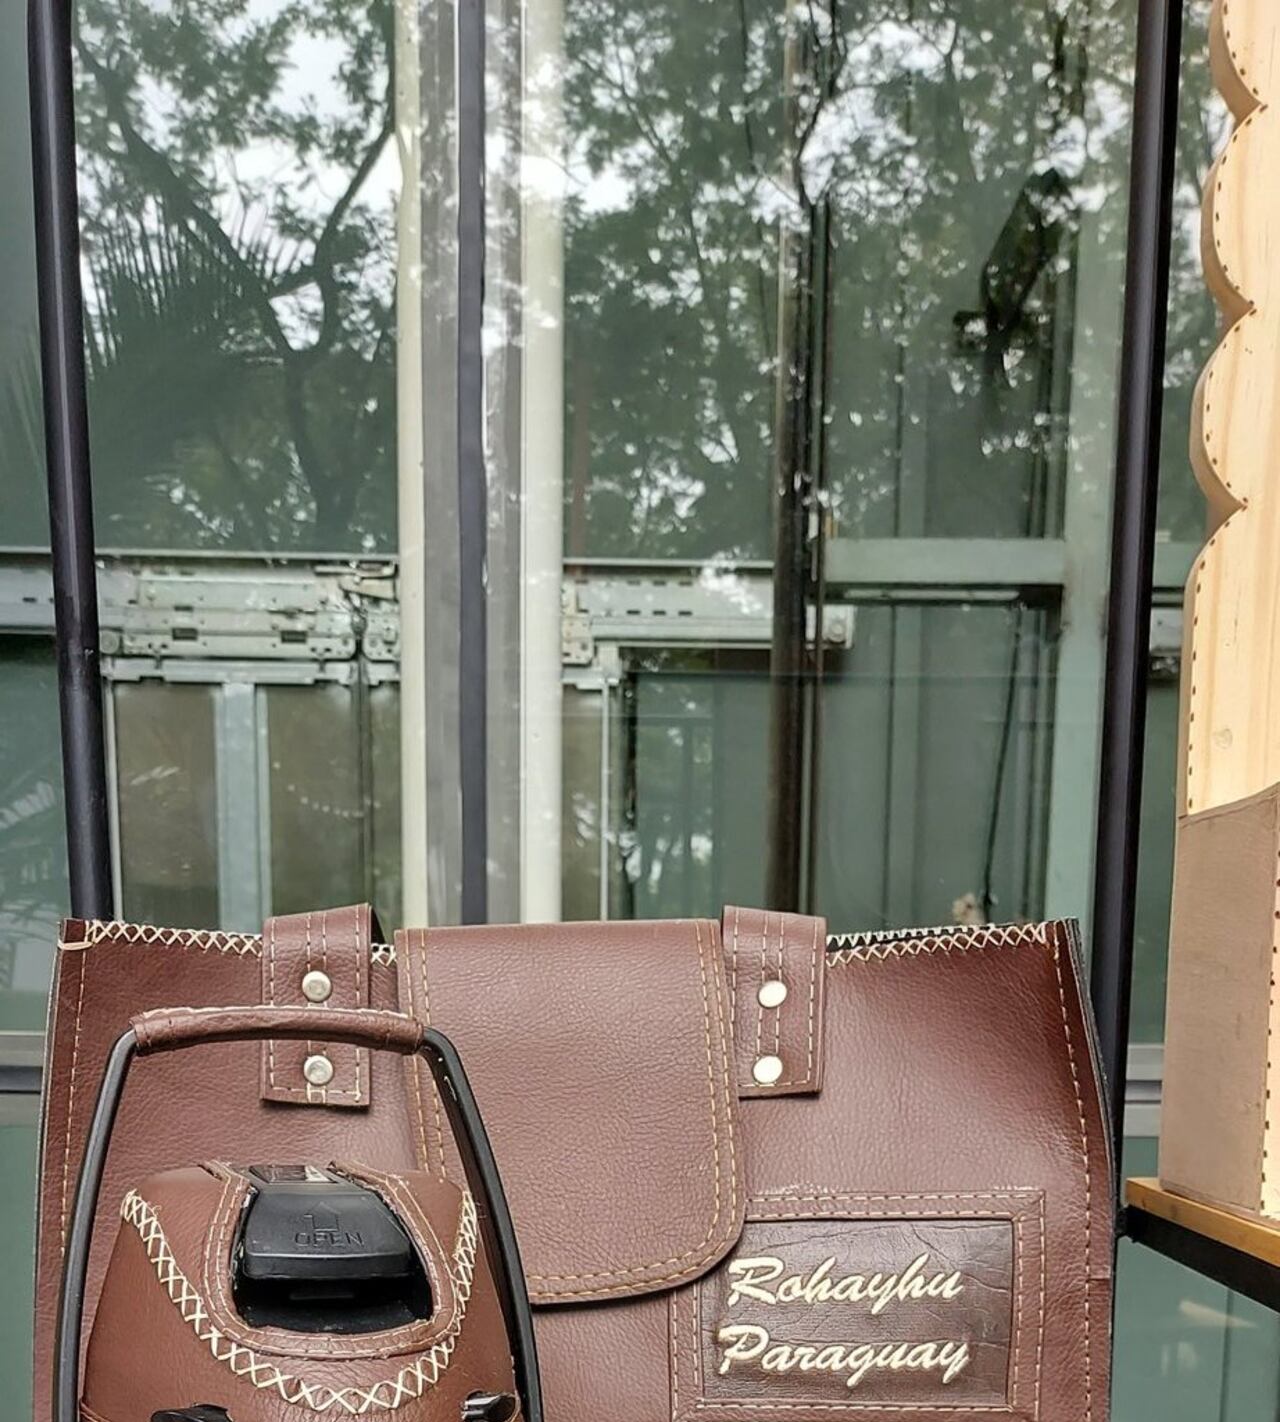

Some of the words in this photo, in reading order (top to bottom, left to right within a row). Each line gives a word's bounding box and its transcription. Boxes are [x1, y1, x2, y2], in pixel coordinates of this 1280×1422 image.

[295, 1232, 364, 1247] OPEN
[727, 1252, 964, 1315] Rohayhu
[718, 1324, 969, 1387] Paraguay
